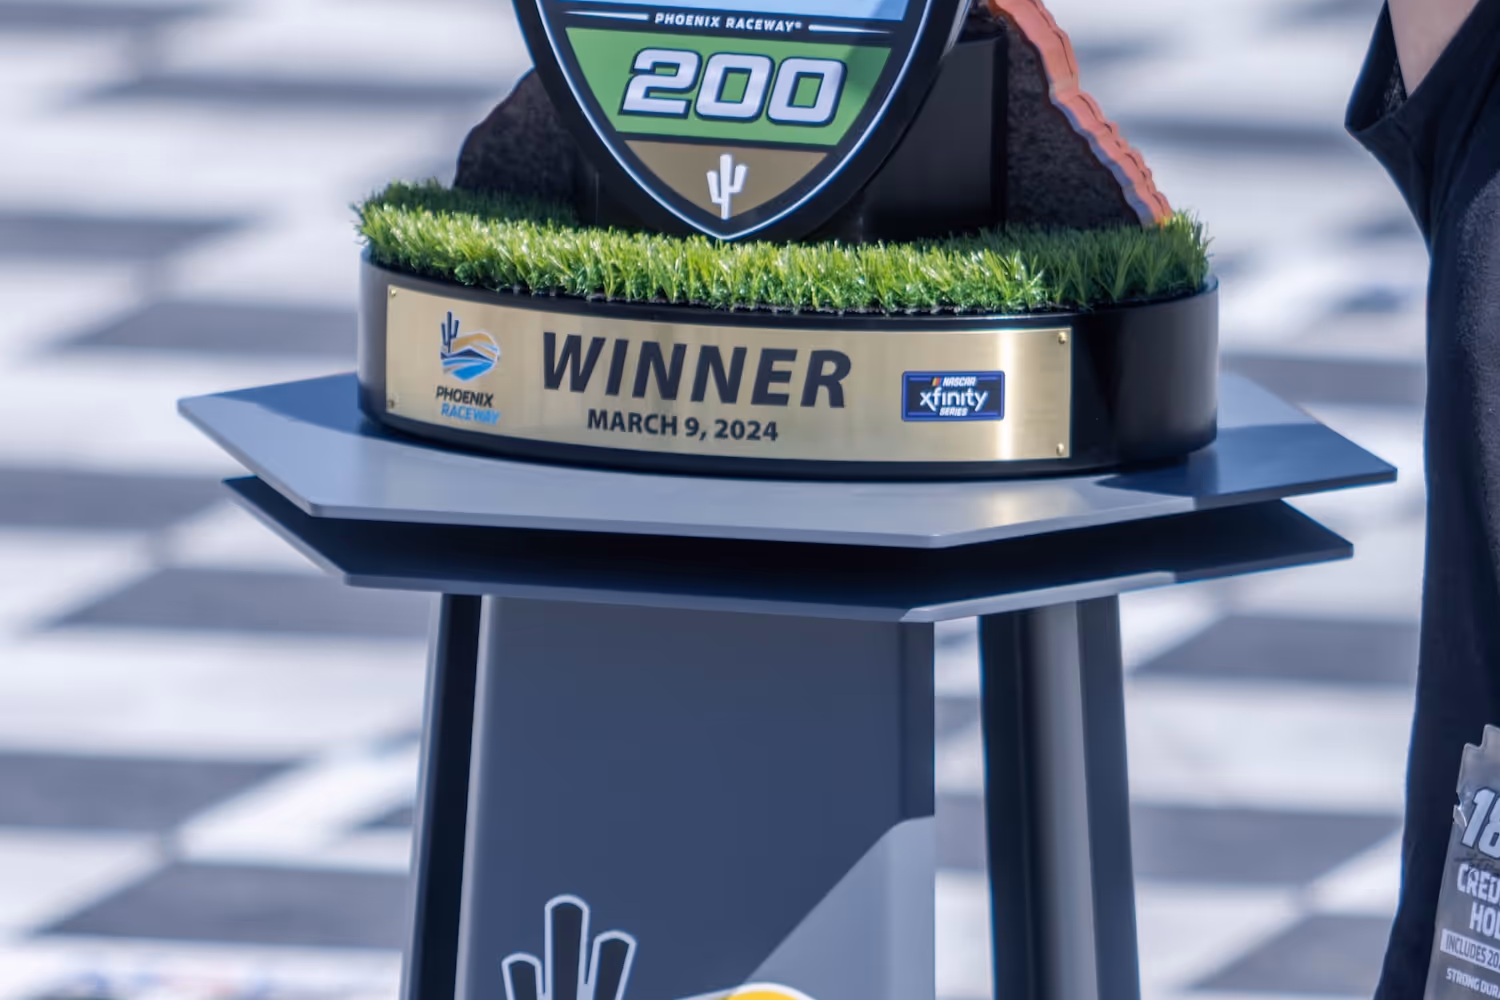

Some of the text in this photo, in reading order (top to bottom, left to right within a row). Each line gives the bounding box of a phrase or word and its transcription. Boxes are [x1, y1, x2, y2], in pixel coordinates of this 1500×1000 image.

[654, 12, 721, 28] PHOENIX
[617, 47, 848, 127] 200
[542, 331, 852, 409] WINNER
[942, 376, 977, 387] NASCAR
[436, 385, 494, 408] PHOENIX
[919, 387, 989, 412] xfinity
[441, 402, 501, 426] RACEWAY
[939, 407, 969, 417] SERIES
[587, 408, 779, 442] MARCH 9, 2024
[1445, 934, 1487, 964] INCLUDES
[1445, 967, 1480, 991] STRONG
